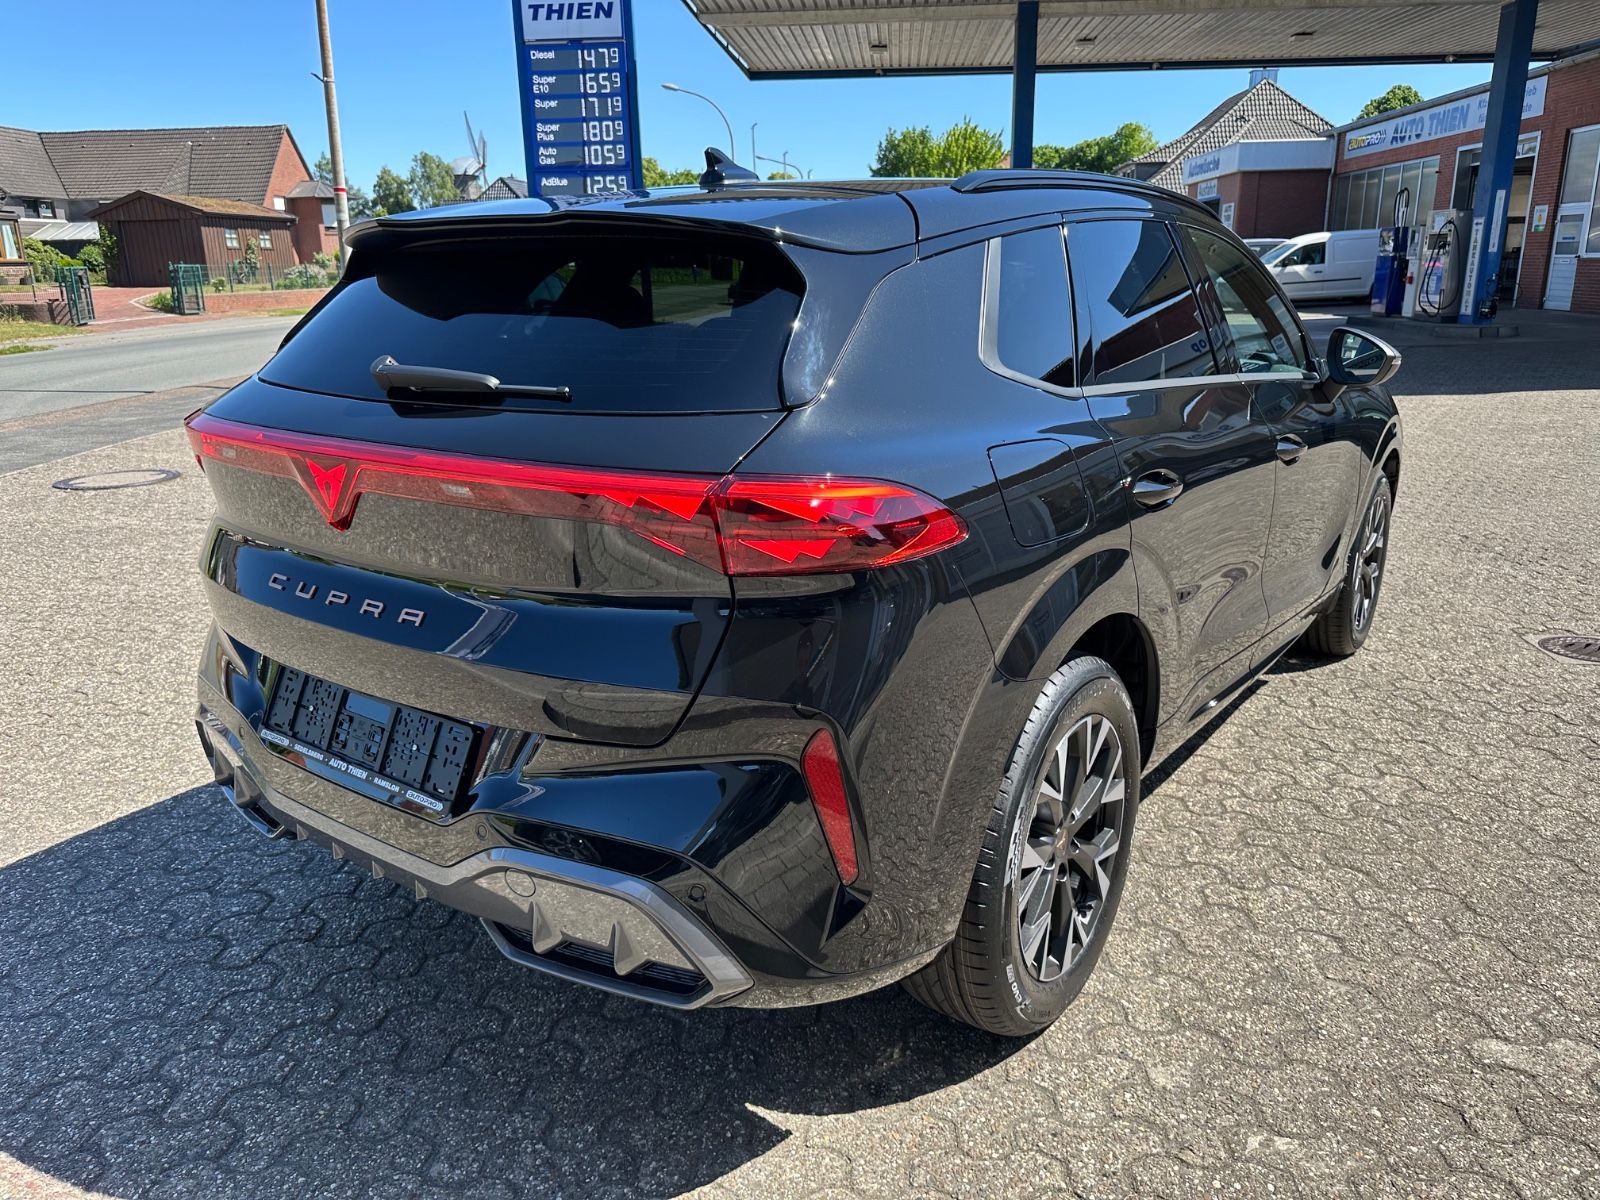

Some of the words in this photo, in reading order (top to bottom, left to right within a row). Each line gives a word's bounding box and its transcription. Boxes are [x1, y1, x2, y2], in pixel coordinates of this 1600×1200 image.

[528, 1, 613, 21] THIEN
[530, 51, 555, 59] Diesel
[577, 48, 619, 68] 1479
[532, 75, 556, 84] Super
[579, 72, 620, 93] 1659
[533, 85, 549, 93] E10
[534, 99, 558, 108] Super
[581, 96, 622, 117] 1719
[536, 123, 560, 132] Super
[583, 120, 624, 141] 1809
[1390, 115, 1425, 145] AUTO
[1428, 103, 1471, 136] THIEN
[537, 132, 555, 141] Plus
[538, 147, 557, 155] Auto
[539, 155, 556, 164] Gas
[584, 144, 625, 165] 1059
[541, 177, 568, 186] AdBlue
[586, 176, 627, 194] 1259
[268, 572, 426, 627] CUPRA
[329, 758, 347, 771] AUTO
[347, 764, 368, 779] THIEN
[373, 777, 400, 792] RAMSLOH
